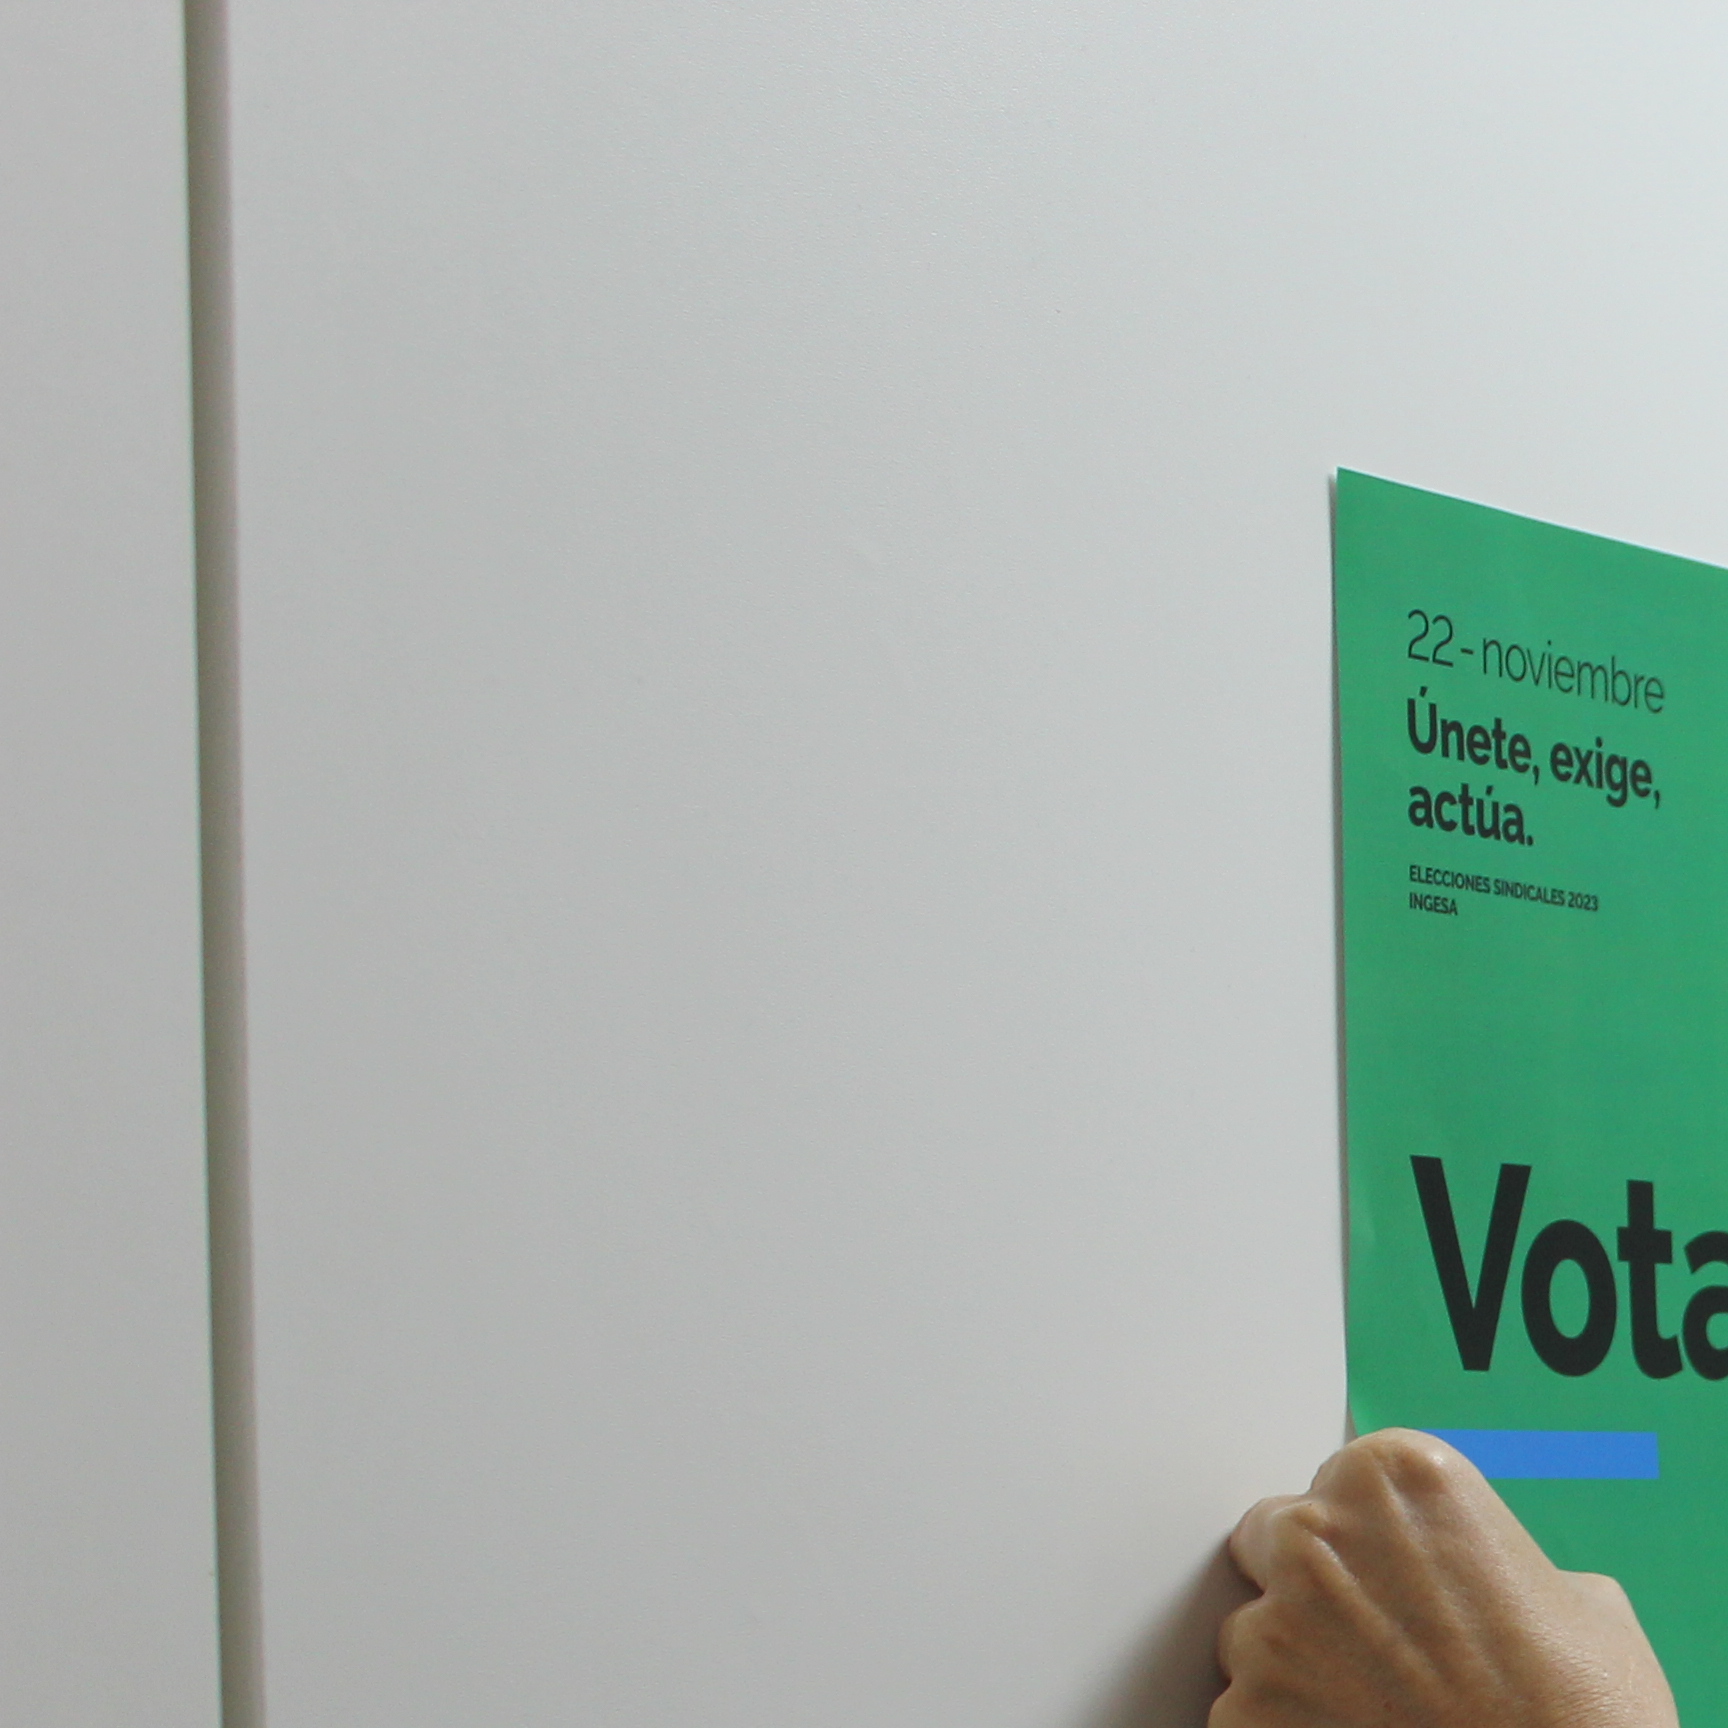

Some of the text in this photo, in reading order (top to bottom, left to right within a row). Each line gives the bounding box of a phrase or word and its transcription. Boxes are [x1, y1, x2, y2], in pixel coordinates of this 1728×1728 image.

[1407, 685, 1661, 810] Únete, exige,
[1407, 782, 1534, 846] actúa.
[1409, 864, 1599, 912] ELECCIONES SINDICALES 2023
[1409, 892, 1458, 916] INGESA
